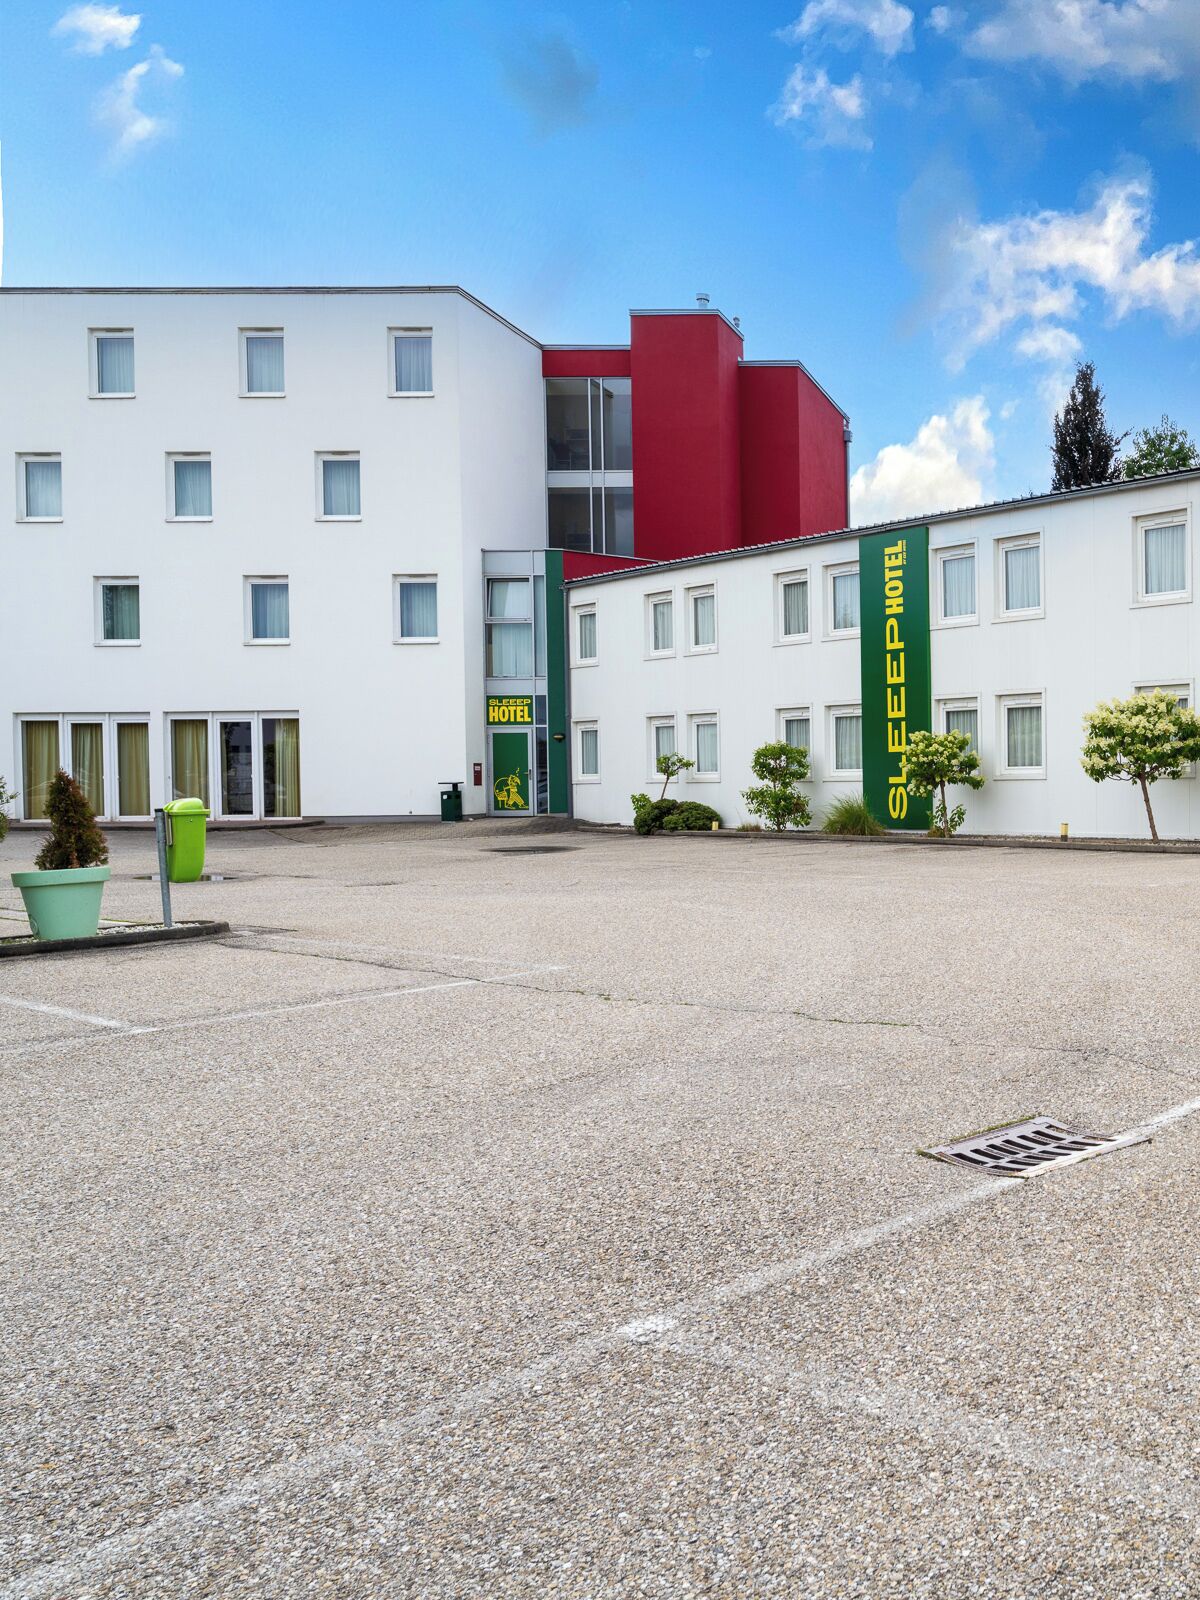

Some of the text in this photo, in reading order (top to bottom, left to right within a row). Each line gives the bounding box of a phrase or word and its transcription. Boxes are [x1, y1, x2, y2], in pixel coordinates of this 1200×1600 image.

[884, 540, 907, 819] SLEEEP HOTEL
[489, 698, 531, 706] SLEEEP
[488, 705, 532, 722] HOTEL
